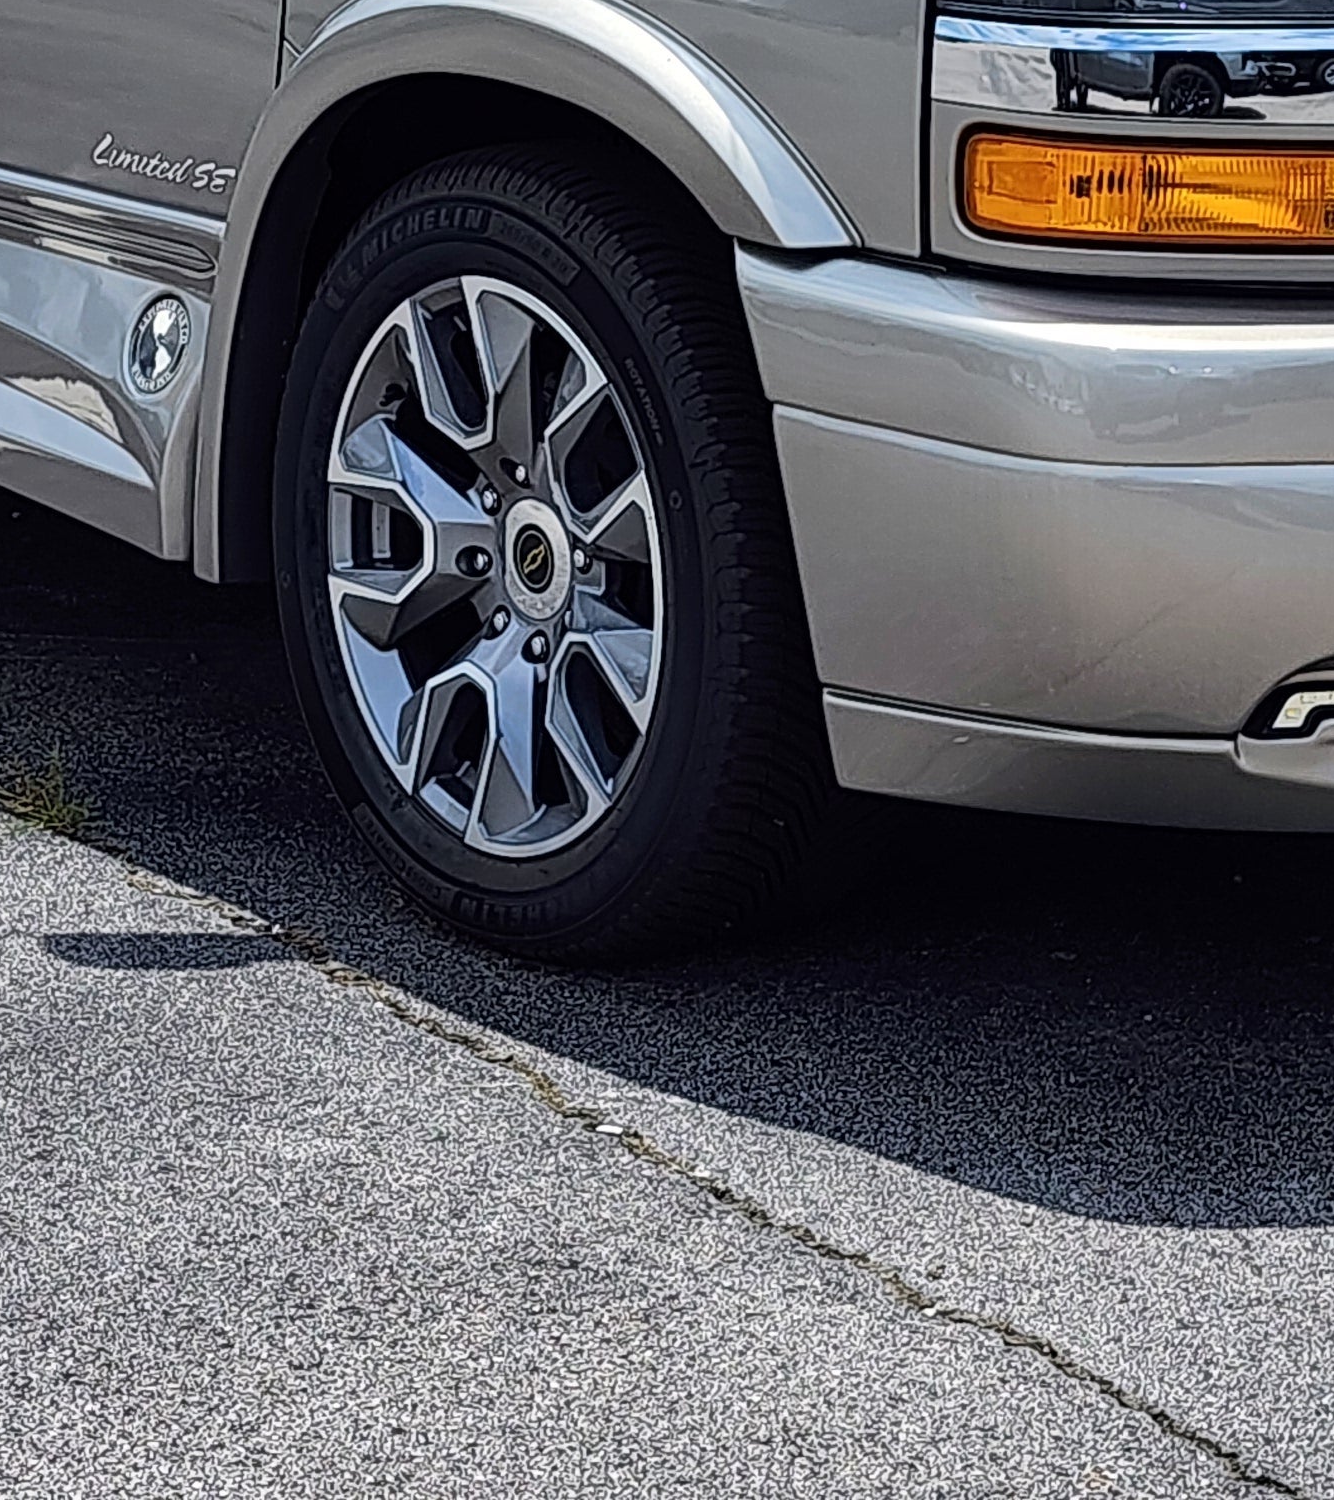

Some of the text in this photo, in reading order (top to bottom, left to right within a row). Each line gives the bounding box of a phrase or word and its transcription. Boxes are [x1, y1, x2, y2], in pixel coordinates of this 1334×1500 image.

[92, 133, 237, 193] Limited SE
[361, 207, 486, 269] MICHELIN
